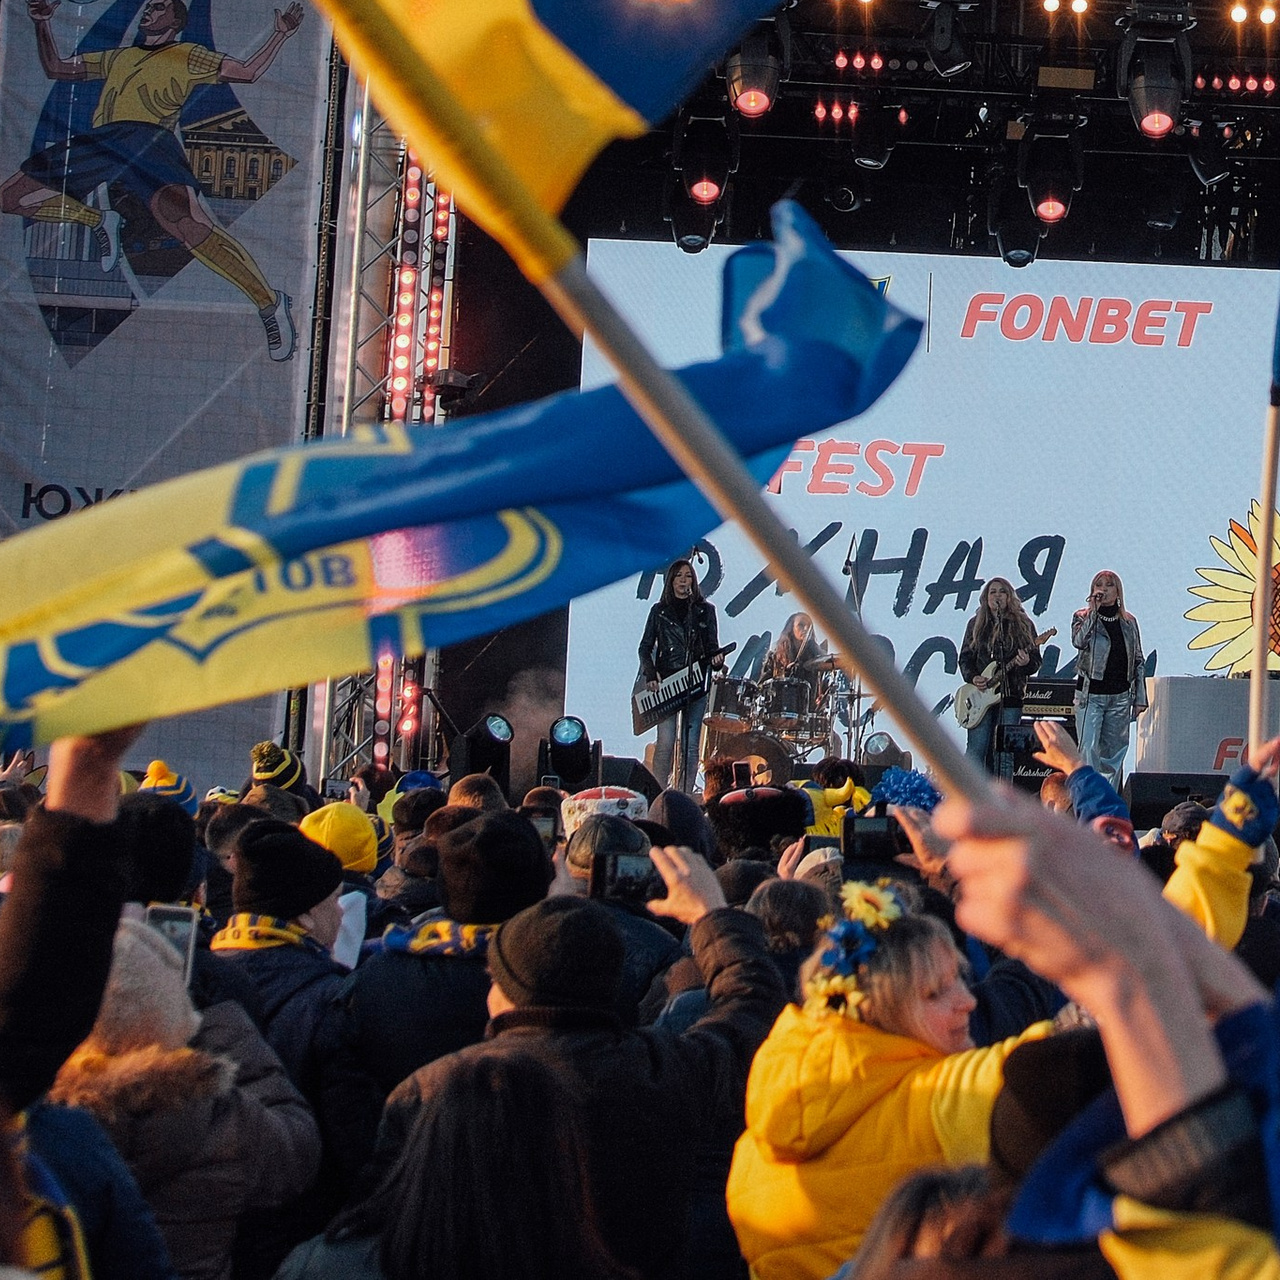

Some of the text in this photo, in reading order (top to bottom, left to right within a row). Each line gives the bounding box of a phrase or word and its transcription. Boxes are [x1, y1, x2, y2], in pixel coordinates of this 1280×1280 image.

[960, 292, 1213, 348] FONBET
[1023, 690, 1053, 700] arshall
[1012, 765, 1053, 777] Marshall
